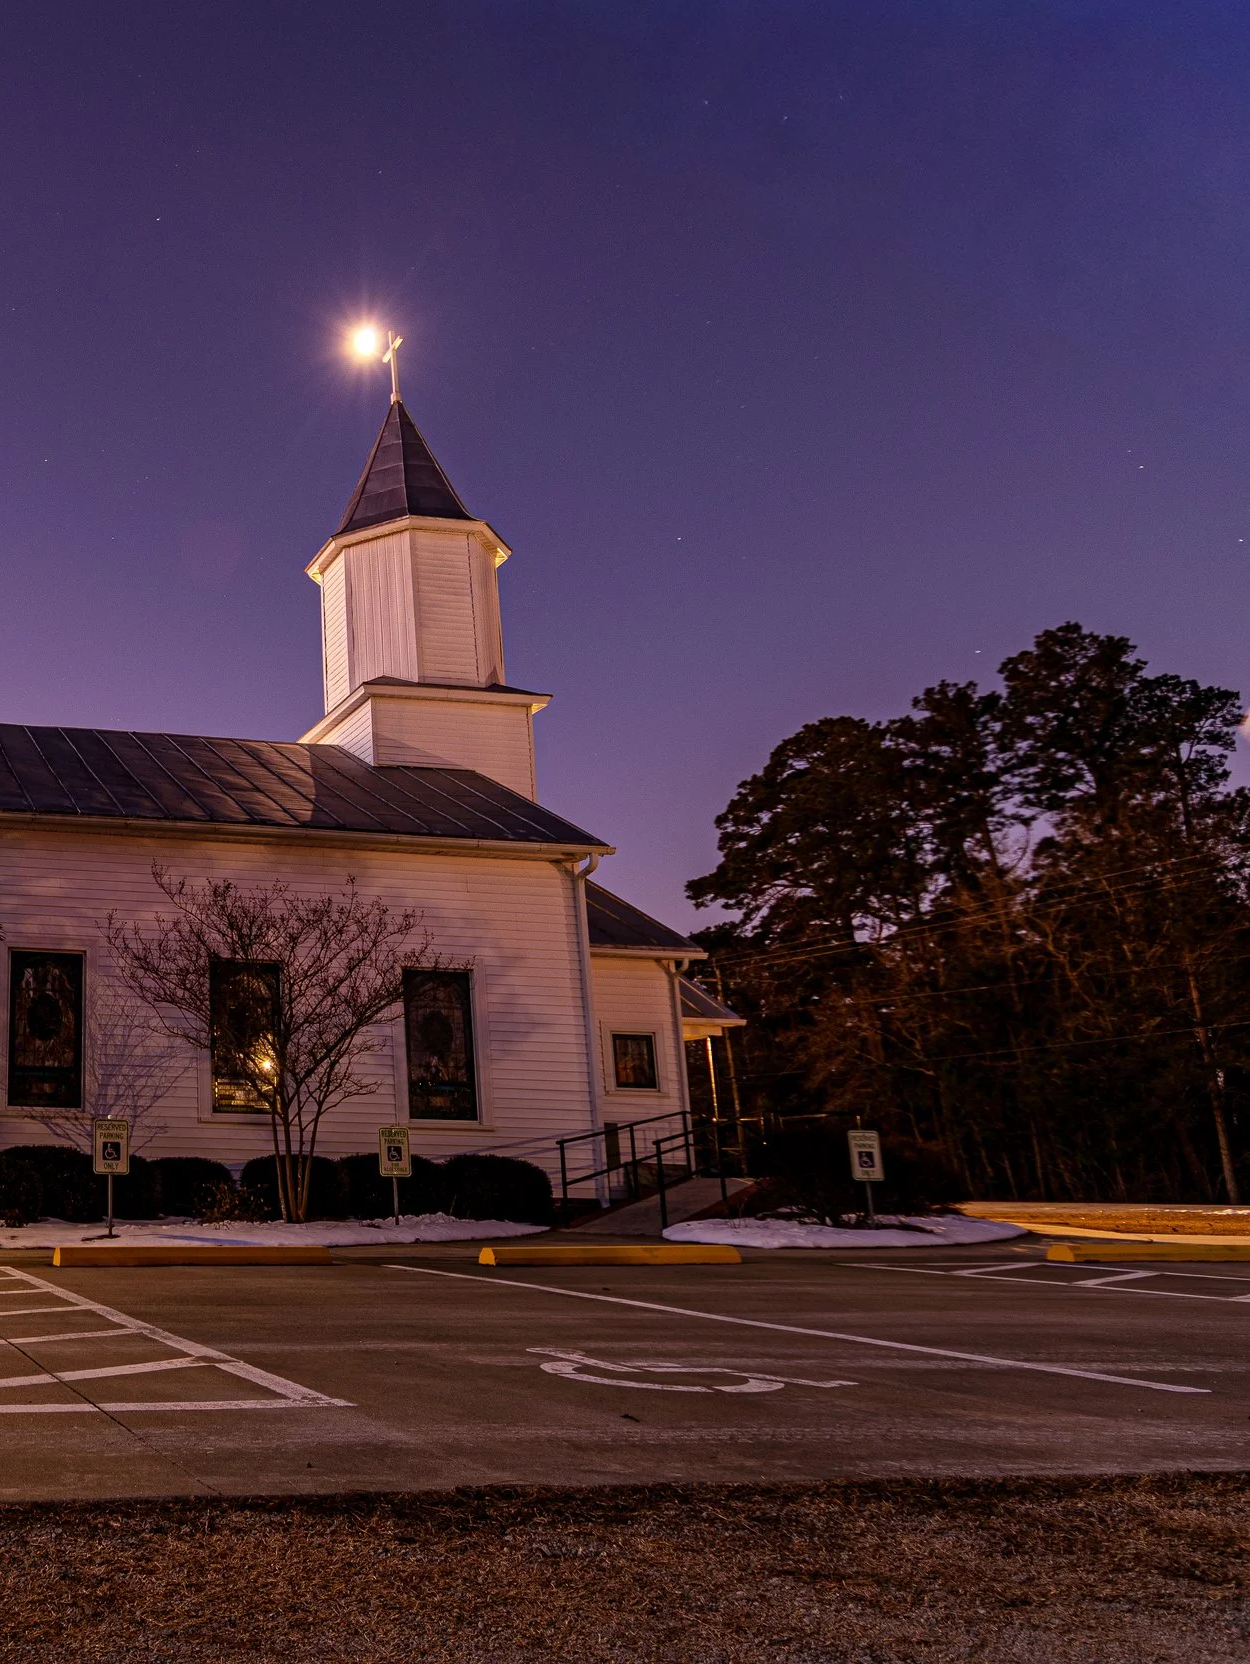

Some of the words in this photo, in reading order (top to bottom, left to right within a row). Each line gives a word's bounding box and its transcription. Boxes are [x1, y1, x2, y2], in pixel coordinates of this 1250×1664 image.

[97, 1123, 127, 1131] RESERVED
[99, 1132, 124, 1140] PARKING
[103, 1162, 119, 1170] ONLY
